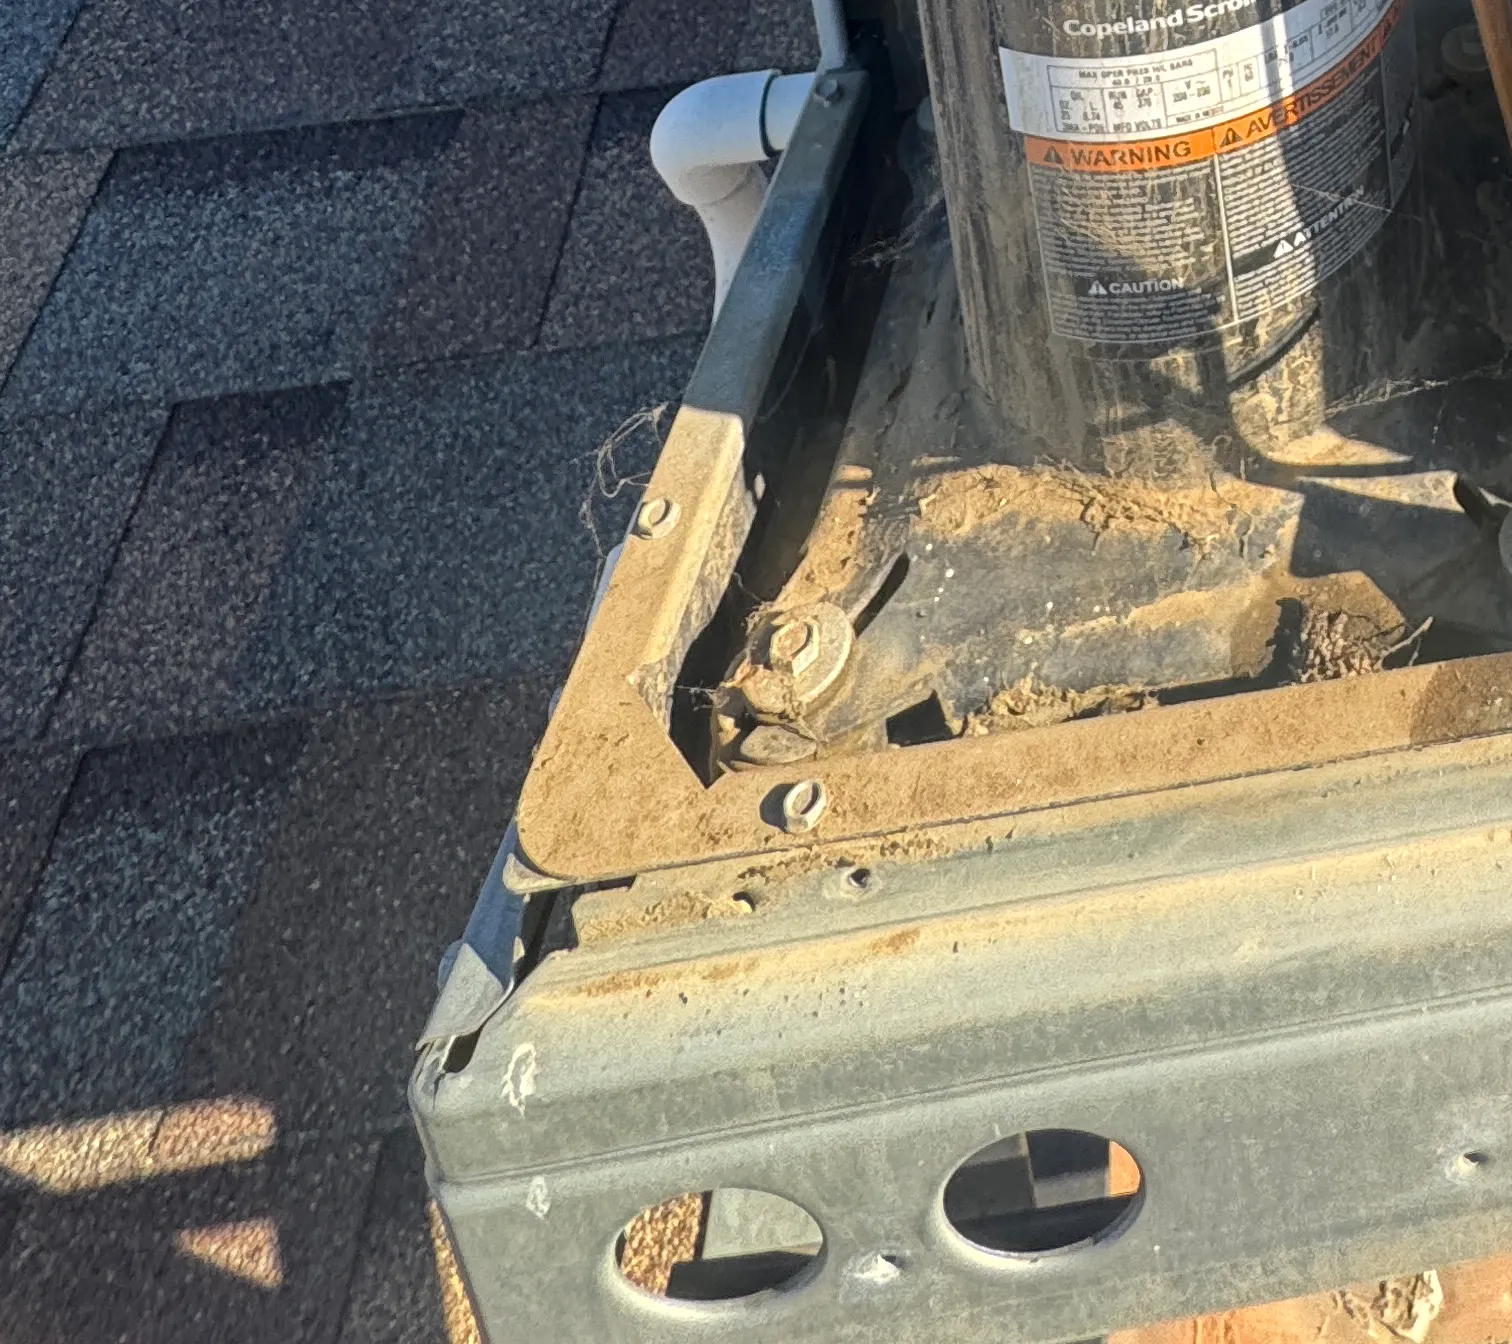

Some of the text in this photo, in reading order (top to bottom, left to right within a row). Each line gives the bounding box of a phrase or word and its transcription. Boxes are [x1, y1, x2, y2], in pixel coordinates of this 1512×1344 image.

[1063, 8, 1183, 39] Copeland
[1070, 141, 1192, 167] WARNING
[1246, 39, 1378, 138] AVERTISSEMENT
[1108, 278, 1185, 294] CAUTION
